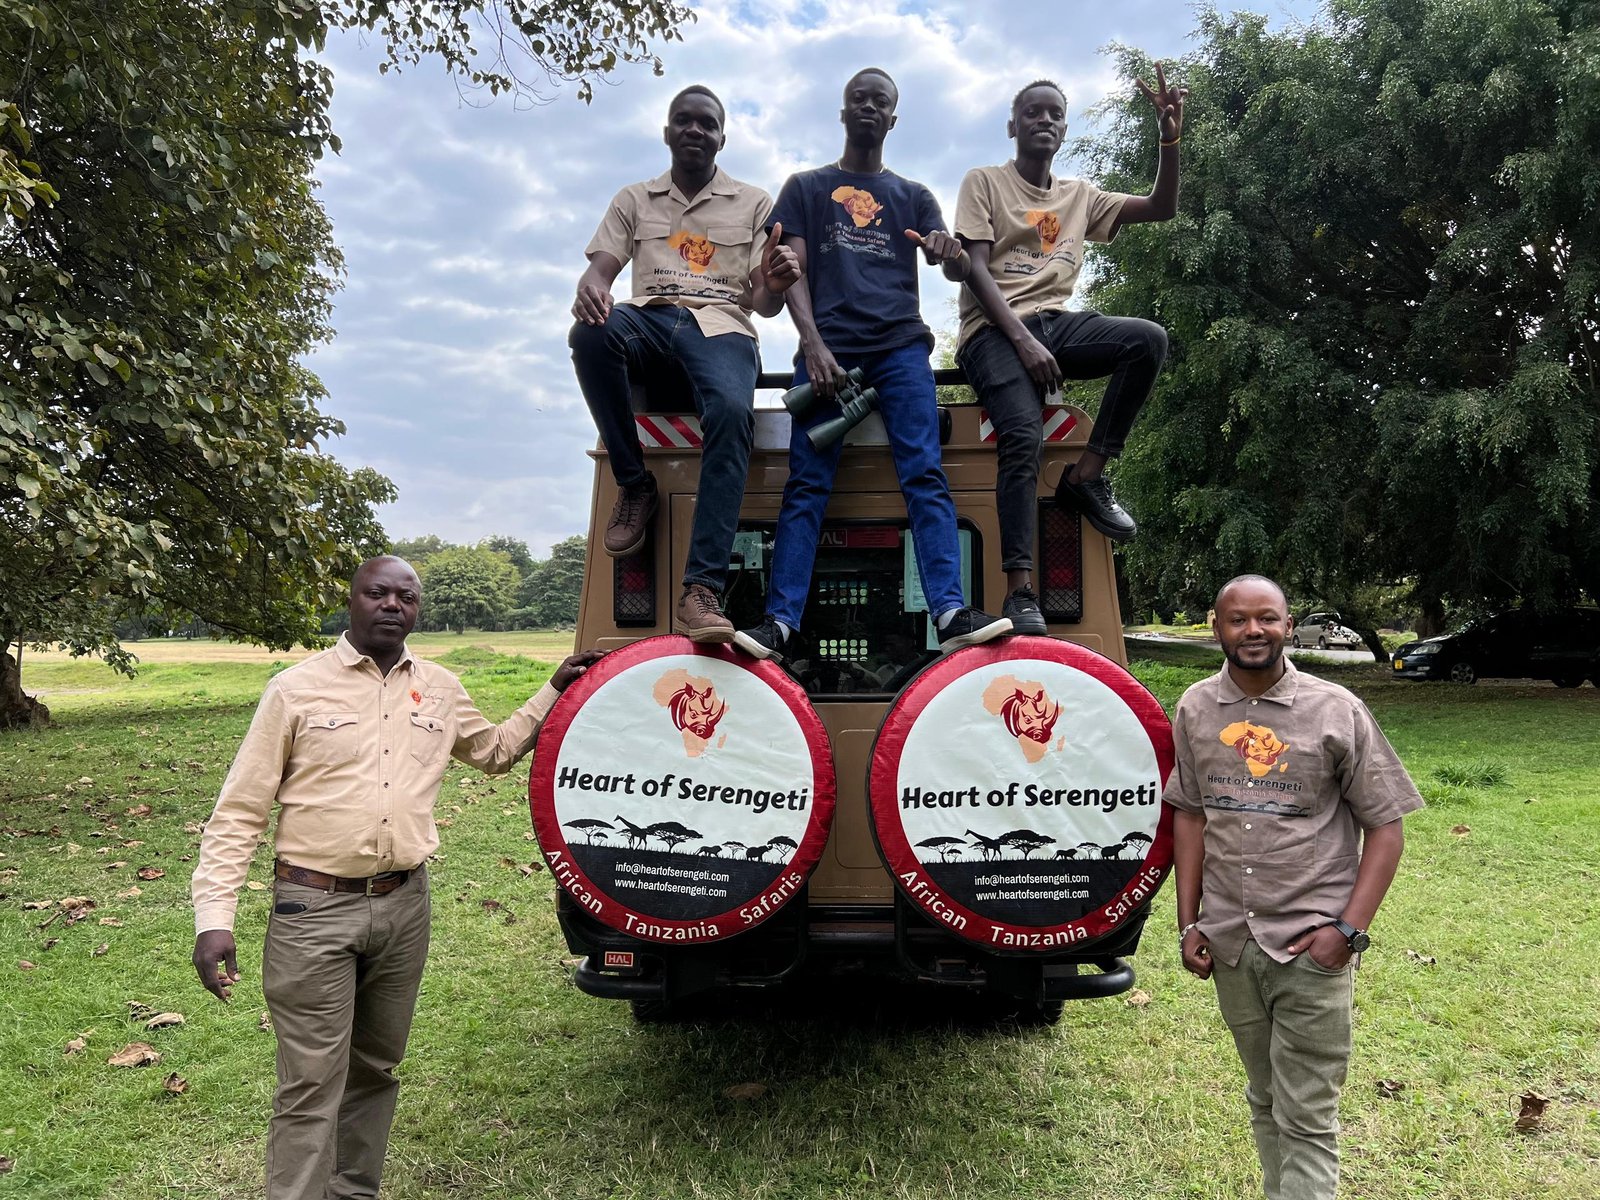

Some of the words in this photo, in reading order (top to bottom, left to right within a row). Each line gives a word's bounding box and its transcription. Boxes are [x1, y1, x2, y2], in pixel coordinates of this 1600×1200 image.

[1010, 246, 1031, 257] Heart
[654, 268, 677, 276] Heart
[689, 273, 729, 285] Serengeti
[816, 531, 843, 545] AL
[558, 766, 636, 795] Heart
[641, 774, 676, 798] of
[678, 777, 808, 813] Serengeti
[1207, 774, 1232, 785] Heart
[1234, 775, 1246, 785] of
[1248, 776, 1303, 792] Serengeti
[902, 782, 979, 809] Heart
[986, 782, 1020, 808] of
[1024, 781, 1156, 812] Serengeti
[615, 861, 730, 882] info@heartofserengeti.com
[974, 873, 1090, 886] info@heartofserengeti.com
[546, 849, 603, 914] African
[624, 913, 719, 940] Tanzania
[739, 870, 802, 925] Safaris
[614, 879, 727, 897] www.heartofserengeti.com
[976, 889, 1089, 901] www.heartofserengeti.com
[900, 870, 967, 931] African
[990, 924, 1088, 947] Tanzania
[1105, 864, 1161, 924] Safaris
[608, 954, 631, 964] HAL
